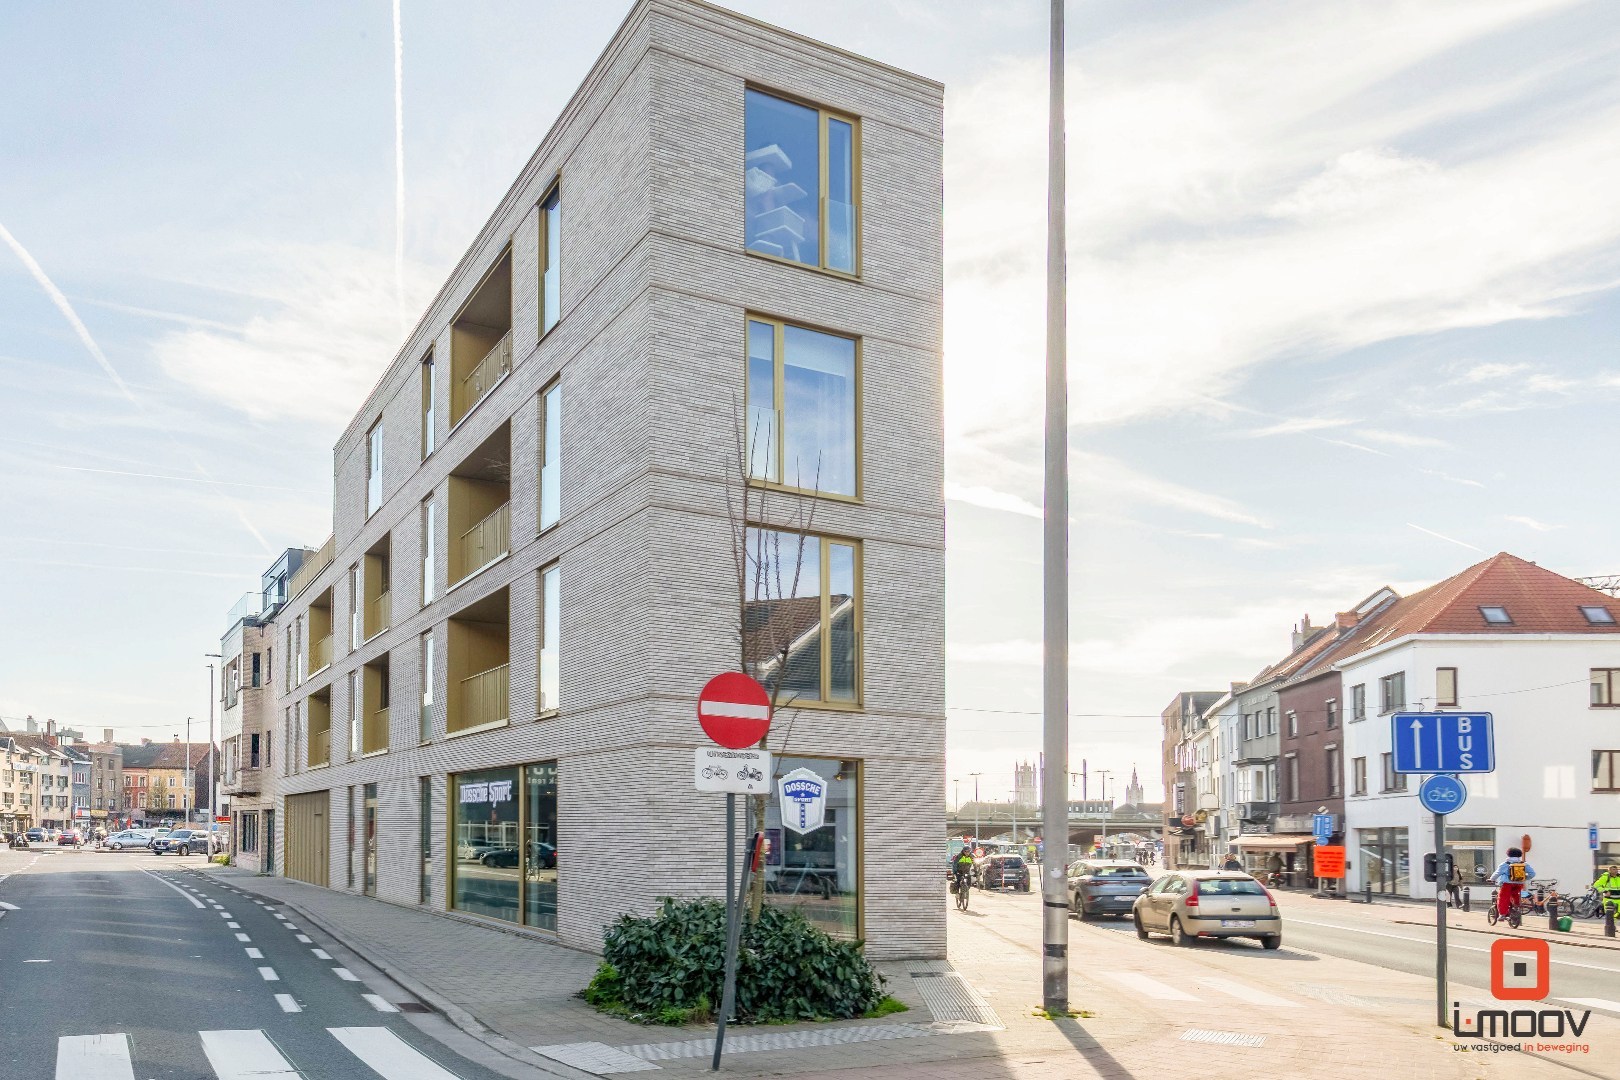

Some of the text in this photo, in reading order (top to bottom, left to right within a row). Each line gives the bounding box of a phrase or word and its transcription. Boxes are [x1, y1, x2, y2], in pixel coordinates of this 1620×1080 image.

[1458, 717, 1473, 770] BUS
[489, 780, 513, 808] Sport
[785, 781, 821, 795] DOSSCHE
